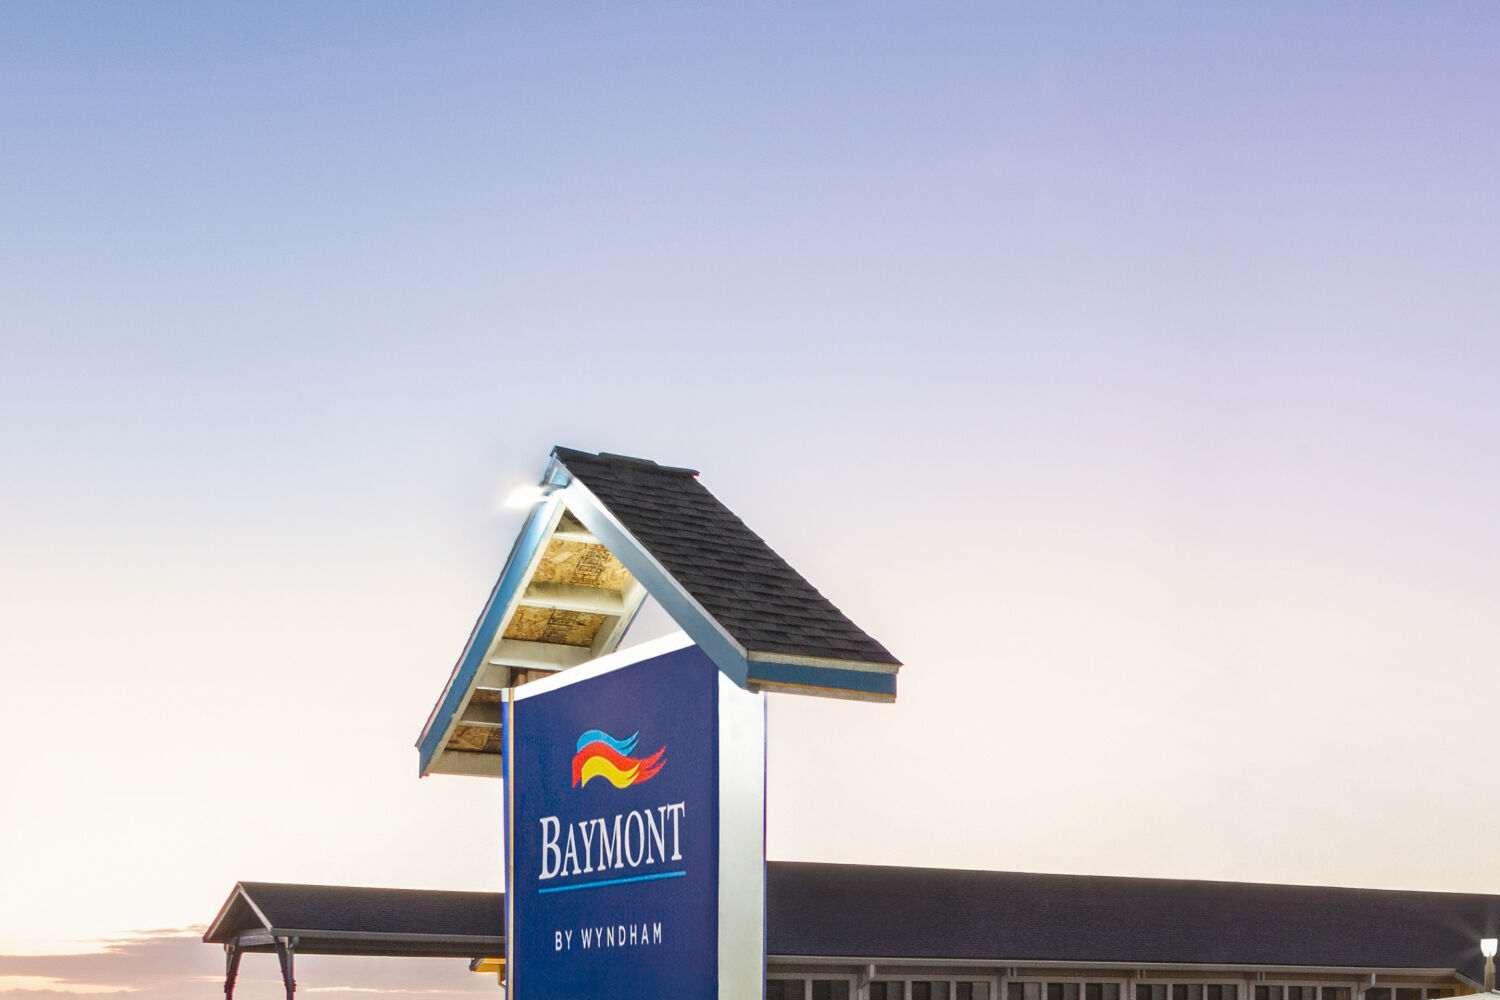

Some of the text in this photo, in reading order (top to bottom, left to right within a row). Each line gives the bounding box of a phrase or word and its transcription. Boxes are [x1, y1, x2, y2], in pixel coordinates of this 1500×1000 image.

[538, 801, 686, 880] BAYMONT
[555, 922, 662, 951] BY WYNDHAM
